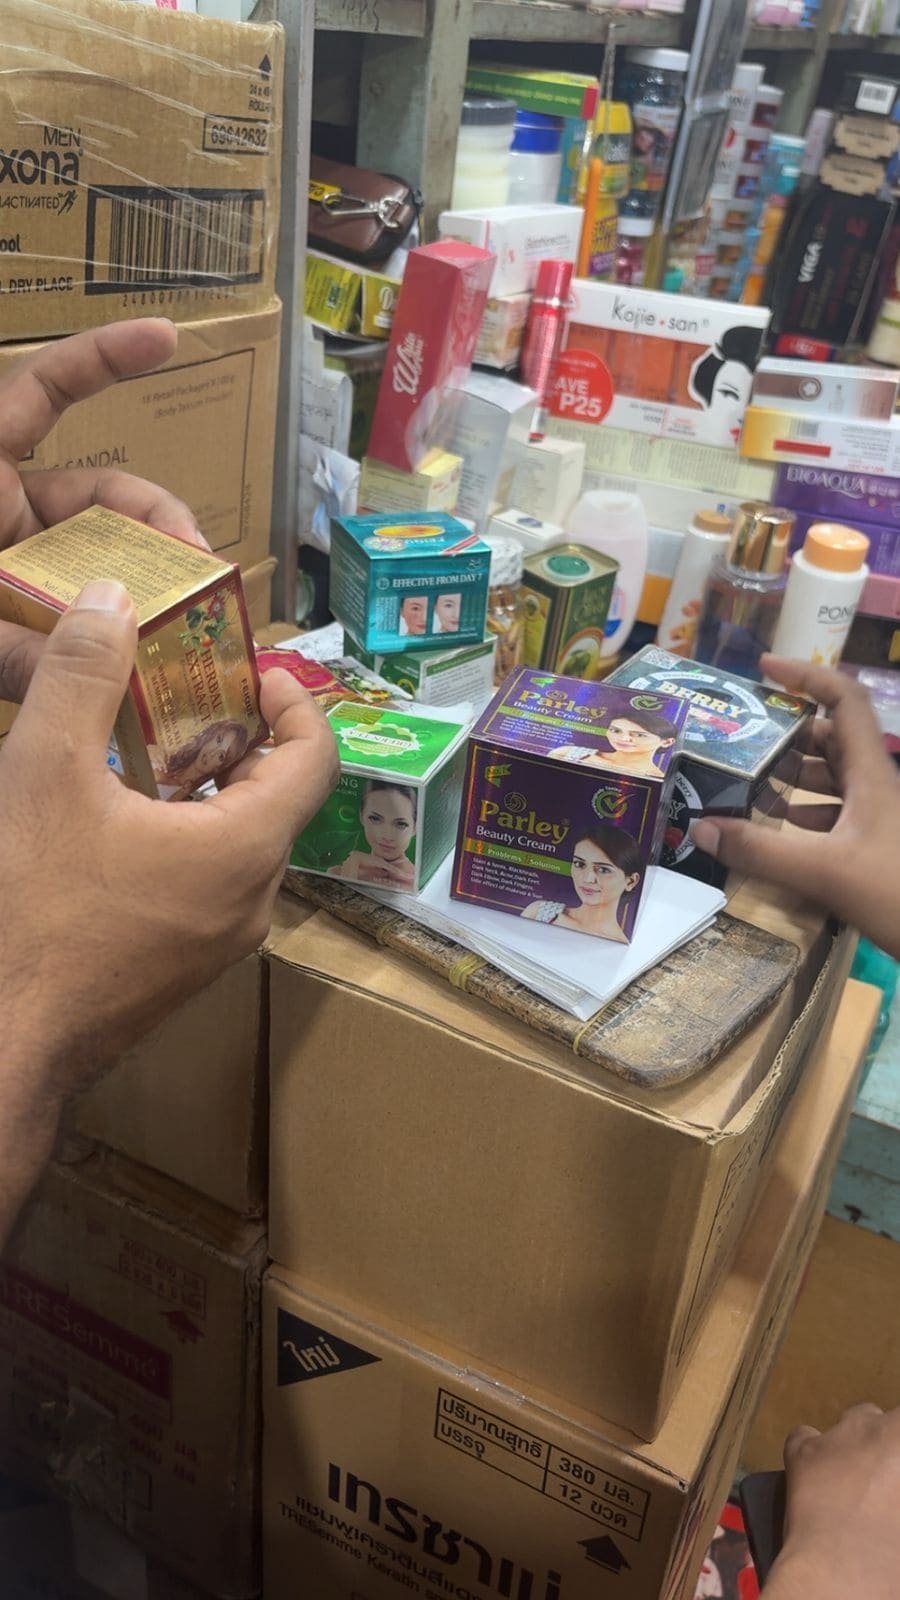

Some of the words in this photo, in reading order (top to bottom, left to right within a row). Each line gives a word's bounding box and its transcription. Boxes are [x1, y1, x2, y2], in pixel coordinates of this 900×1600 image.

[44, 126, 81, 147] MEN
[9, 278, 33, 294] DRY
[36, 276, 73, 292] PLACE
[667, 316, 699, 333] san
[554, 376, 589, 395] AVE
[559, 391, 602, 417] P25
[392, 577, 435, 588] EFFECTIVE
[436, 574, 459, 585] FROM
[460, 573, 476, 583] DAY
[185, 648, 212, 722] EXTRACT
[201, 648, 222, 713] HERBAL
[514, 701, 551, 715] Beauty
[555, 711, 592, 724] Cream
[519, 690, 606, 719] Parley
[656, 681, 749, 718] BERRY
[479, 800, 569, 845] Parley
[476, 825, 515, 846] Beauty
[517, 836, 557, 854] Cream
[488, 847, 522, 863] Problems
[530, 859, 561, 871] Solution
[283, 1336, 341, 1372] ใหม่
[442, 1398, 542, 1459] ปริมาณสุทธิ
[559, 1457, 595, 1485] 380
[604, 1480, 635, 1507] มล.
[440, 1422, 486, 1458] บรรจุ
[559, 1484, 583, 1505] 12
[590, 1500, 627, 1528] ขวด
